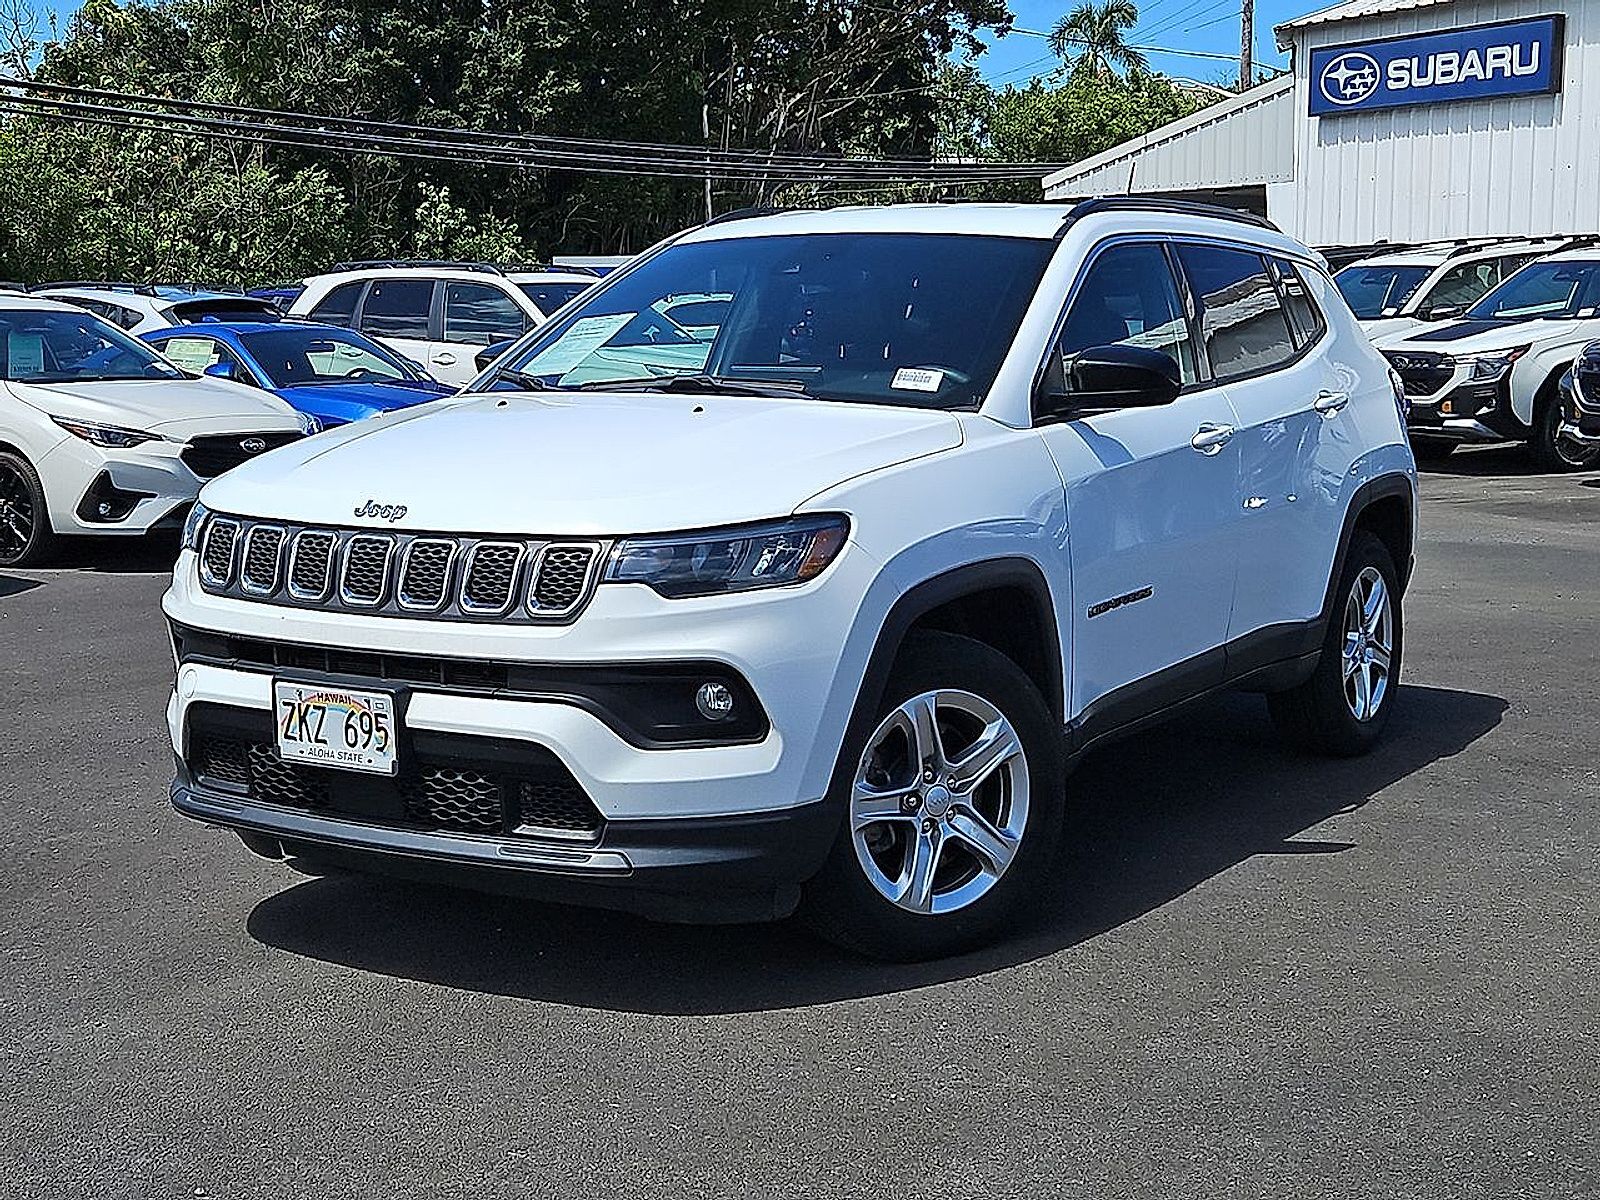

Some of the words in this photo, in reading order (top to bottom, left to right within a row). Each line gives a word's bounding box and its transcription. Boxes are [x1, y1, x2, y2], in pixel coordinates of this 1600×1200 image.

[1386, 41, 1540, 90] SUBARU
[316, 691, 352, 705] HAWAII
[281, 700, 328, 745] ZKZ
[344, 708, 389, 753] 695
[307, 747, 335, 759] ALOHA
[337, 751, 364, 763] STATE
